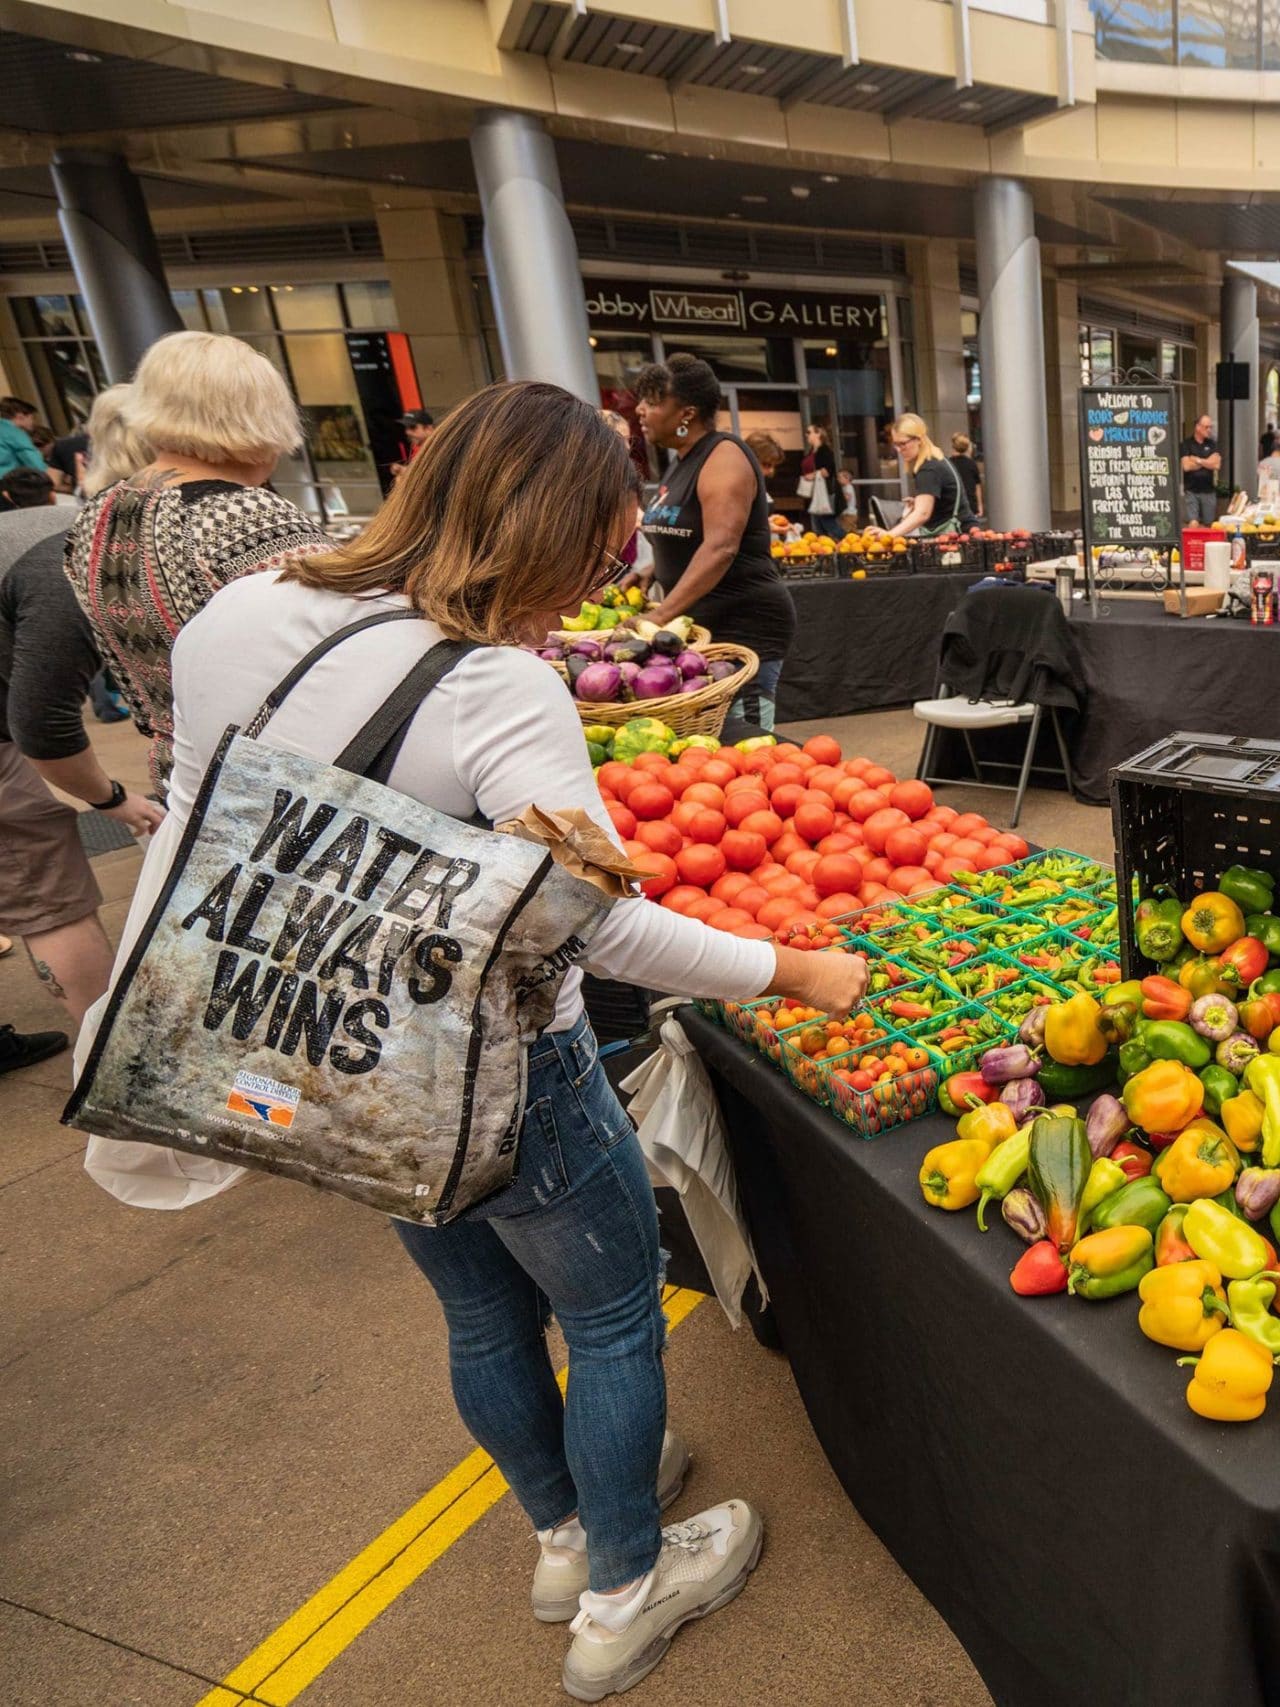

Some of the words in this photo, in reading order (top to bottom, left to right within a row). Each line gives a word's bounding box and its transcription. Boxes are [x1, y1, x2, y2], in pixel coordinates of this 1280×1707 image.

[586, 293, 648, 322] obby
[654, 296, 737, 322] Wheat
[749, 300, 879, 328] GALLERY
[1097, 393, 1139, 408] WELCOME
[1129, 410, 1169, 425] PRODUCE
[249, 788, 482, 930] WATER
[181, 862, 463, 1005] ALWAYS
[202, 950, 390, 1075] WINS
[239, 1071, 276, 1087] REGIONAL
